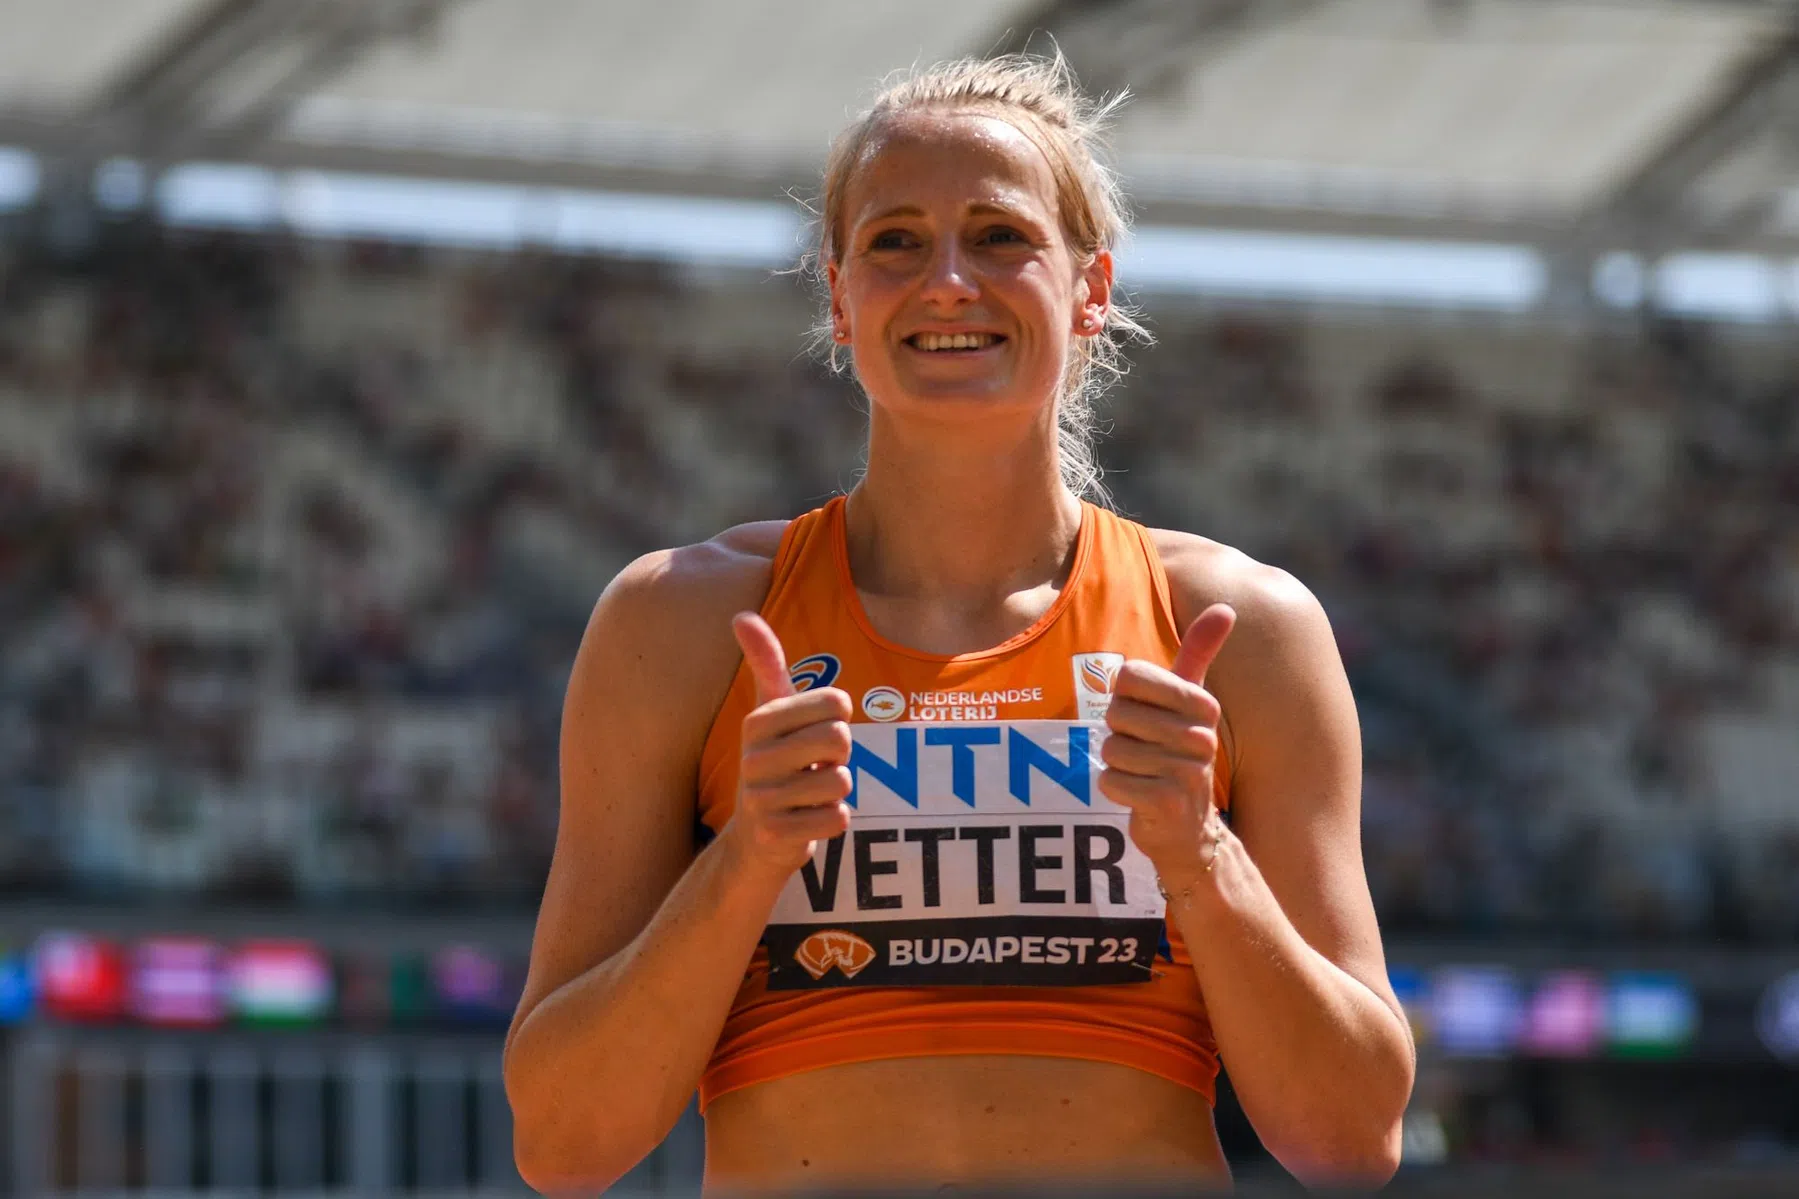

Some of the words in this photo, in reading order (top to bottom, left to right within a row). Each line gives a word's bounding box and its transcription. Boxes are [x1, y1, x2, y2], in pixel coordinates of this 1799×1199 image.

[910, 688, 1043, 705] NEDERLANDSE
[909, 705, 997, 720] LOTERIJ
[845, 726, 1090, 809] NTN
[801, 825, 1127, 912] VETTER
[888, 936, 1094, 966] BUDAPEST
[1098, 937, 1138, 963] 23
